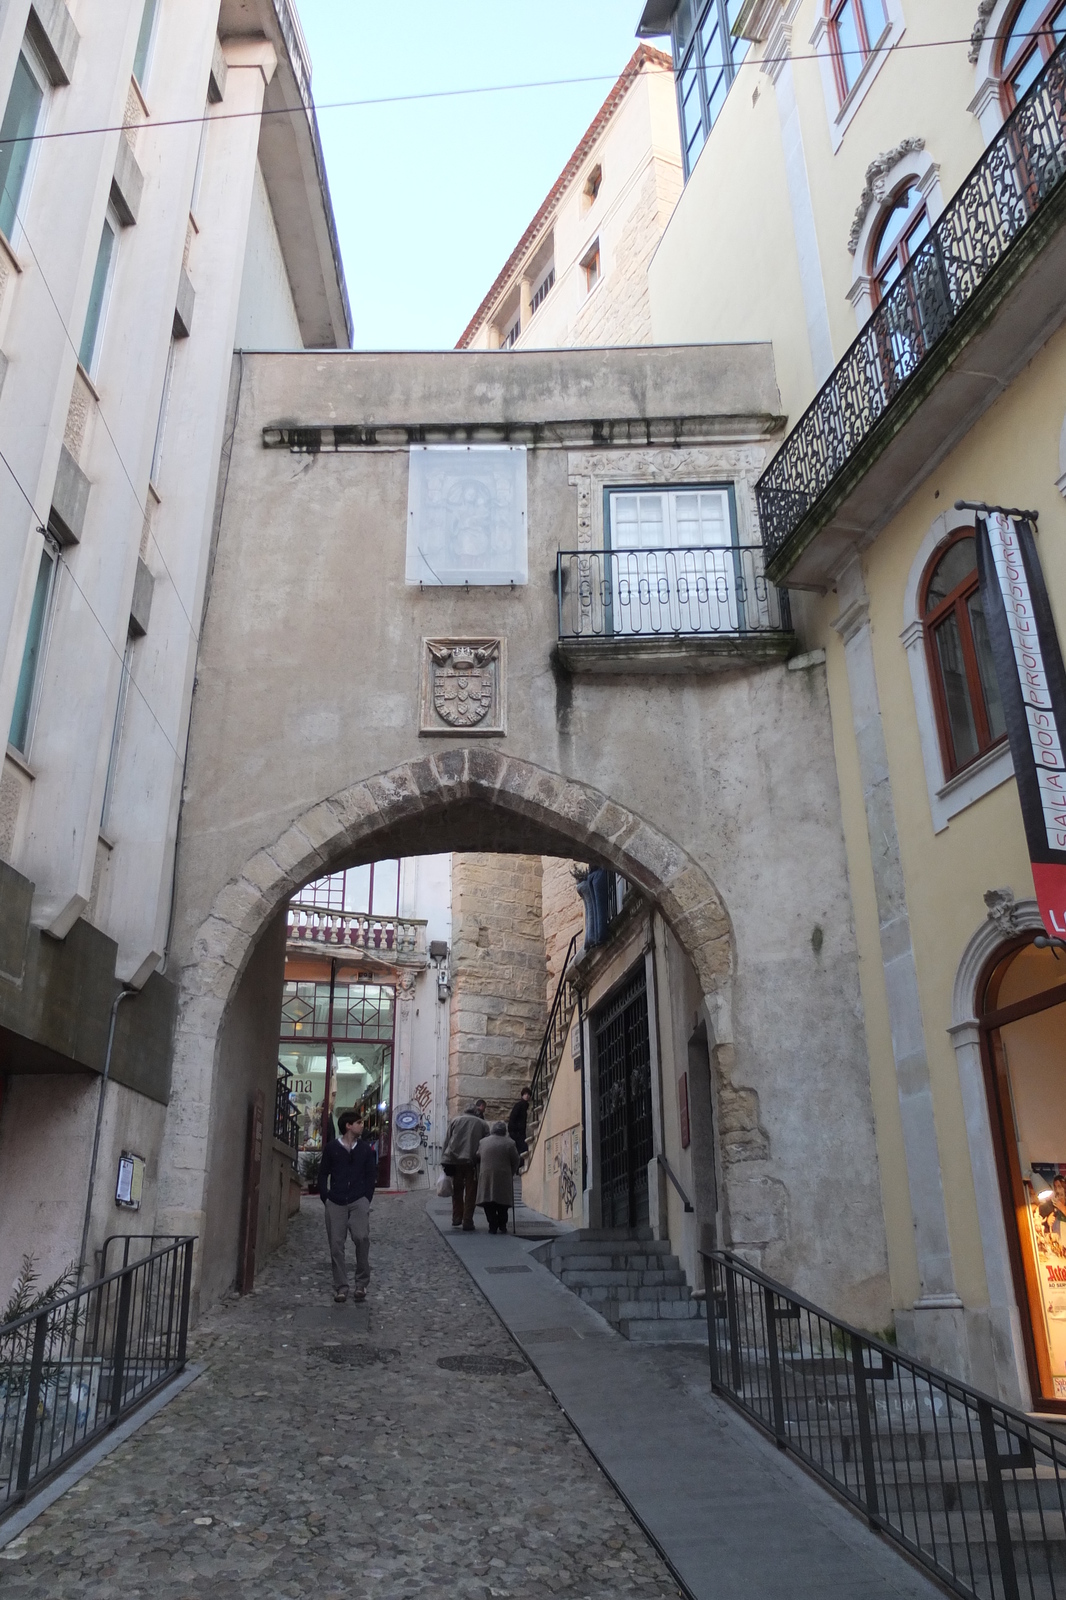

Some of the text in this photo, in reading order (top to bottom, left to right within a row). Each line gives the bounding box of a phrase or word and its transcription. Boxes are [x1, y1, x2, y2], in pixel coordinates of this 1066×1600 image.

[995, 514, 1066, 847] SALA DOS PROFESSORES
[1049, 909, 1066, 932] L
